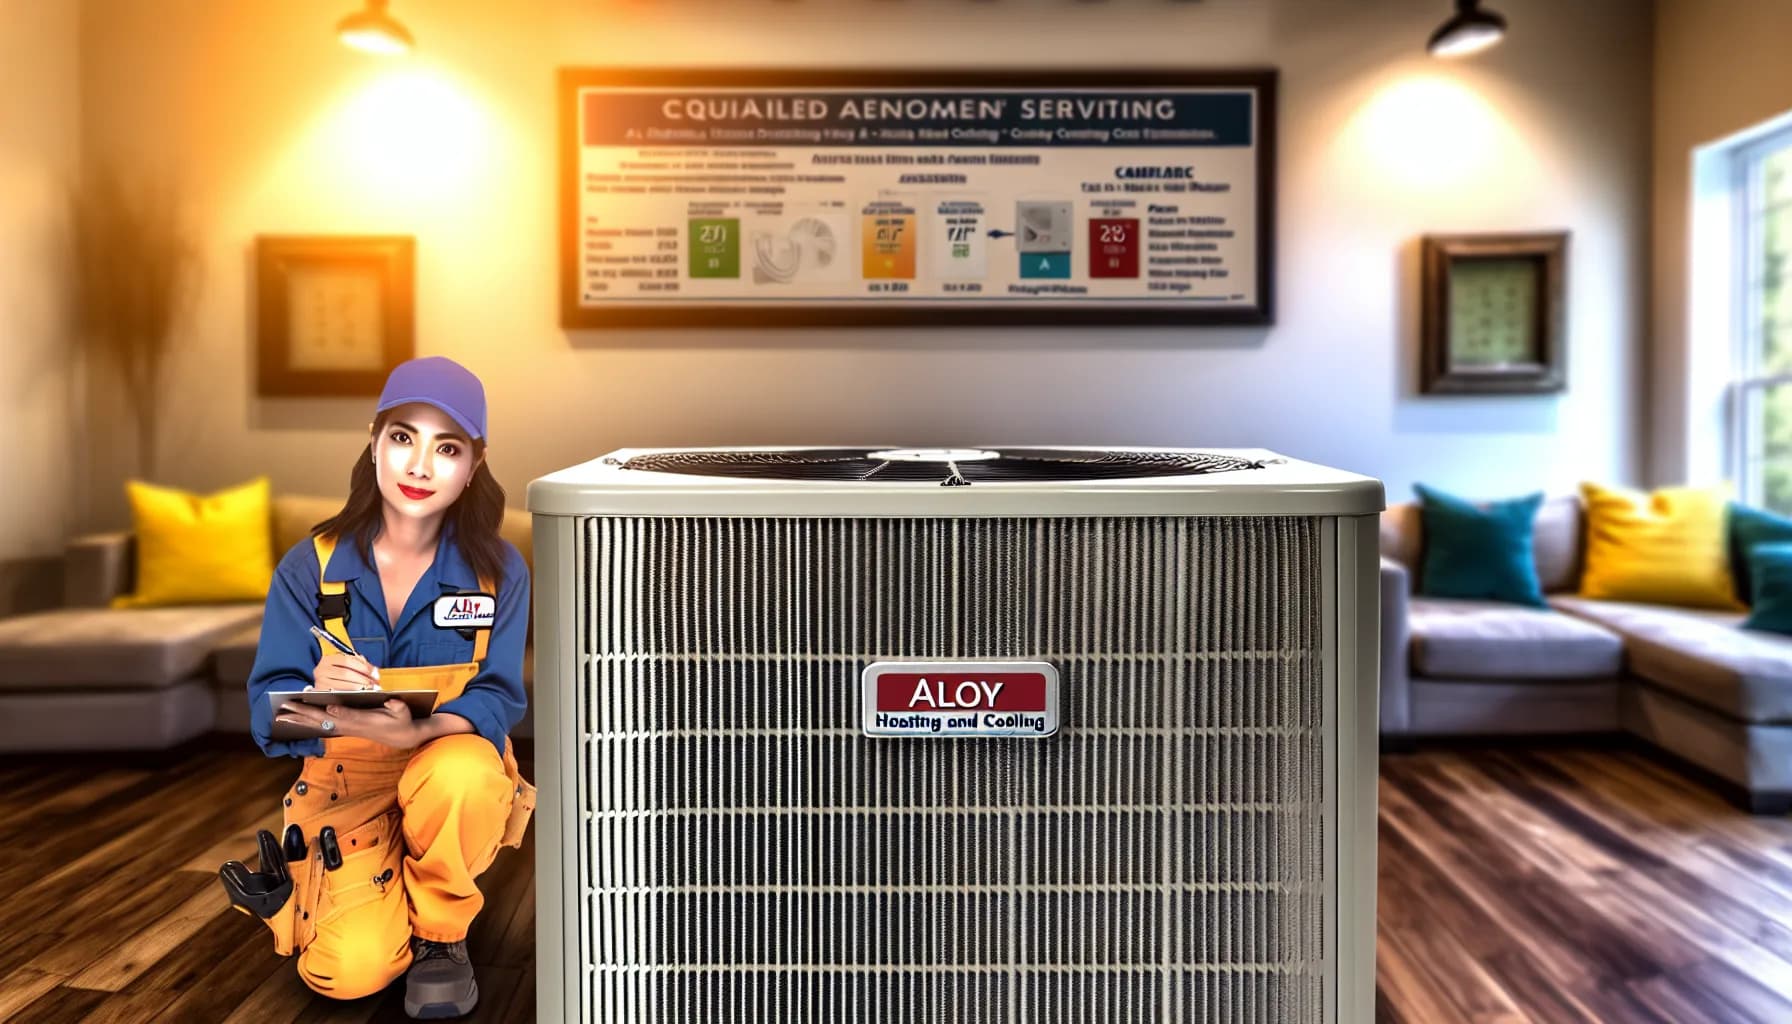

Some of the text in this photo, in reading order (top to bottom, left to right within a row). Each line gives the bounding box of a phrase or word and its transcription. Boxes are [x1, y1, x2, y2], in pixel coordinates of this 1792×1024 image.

[1020, 98, 1176, 120] SERVITING
[908, 677, 1004, 708] ALOY
[947, 712, 978, 728] and
[983, 712, 1045, 732] Cooling
